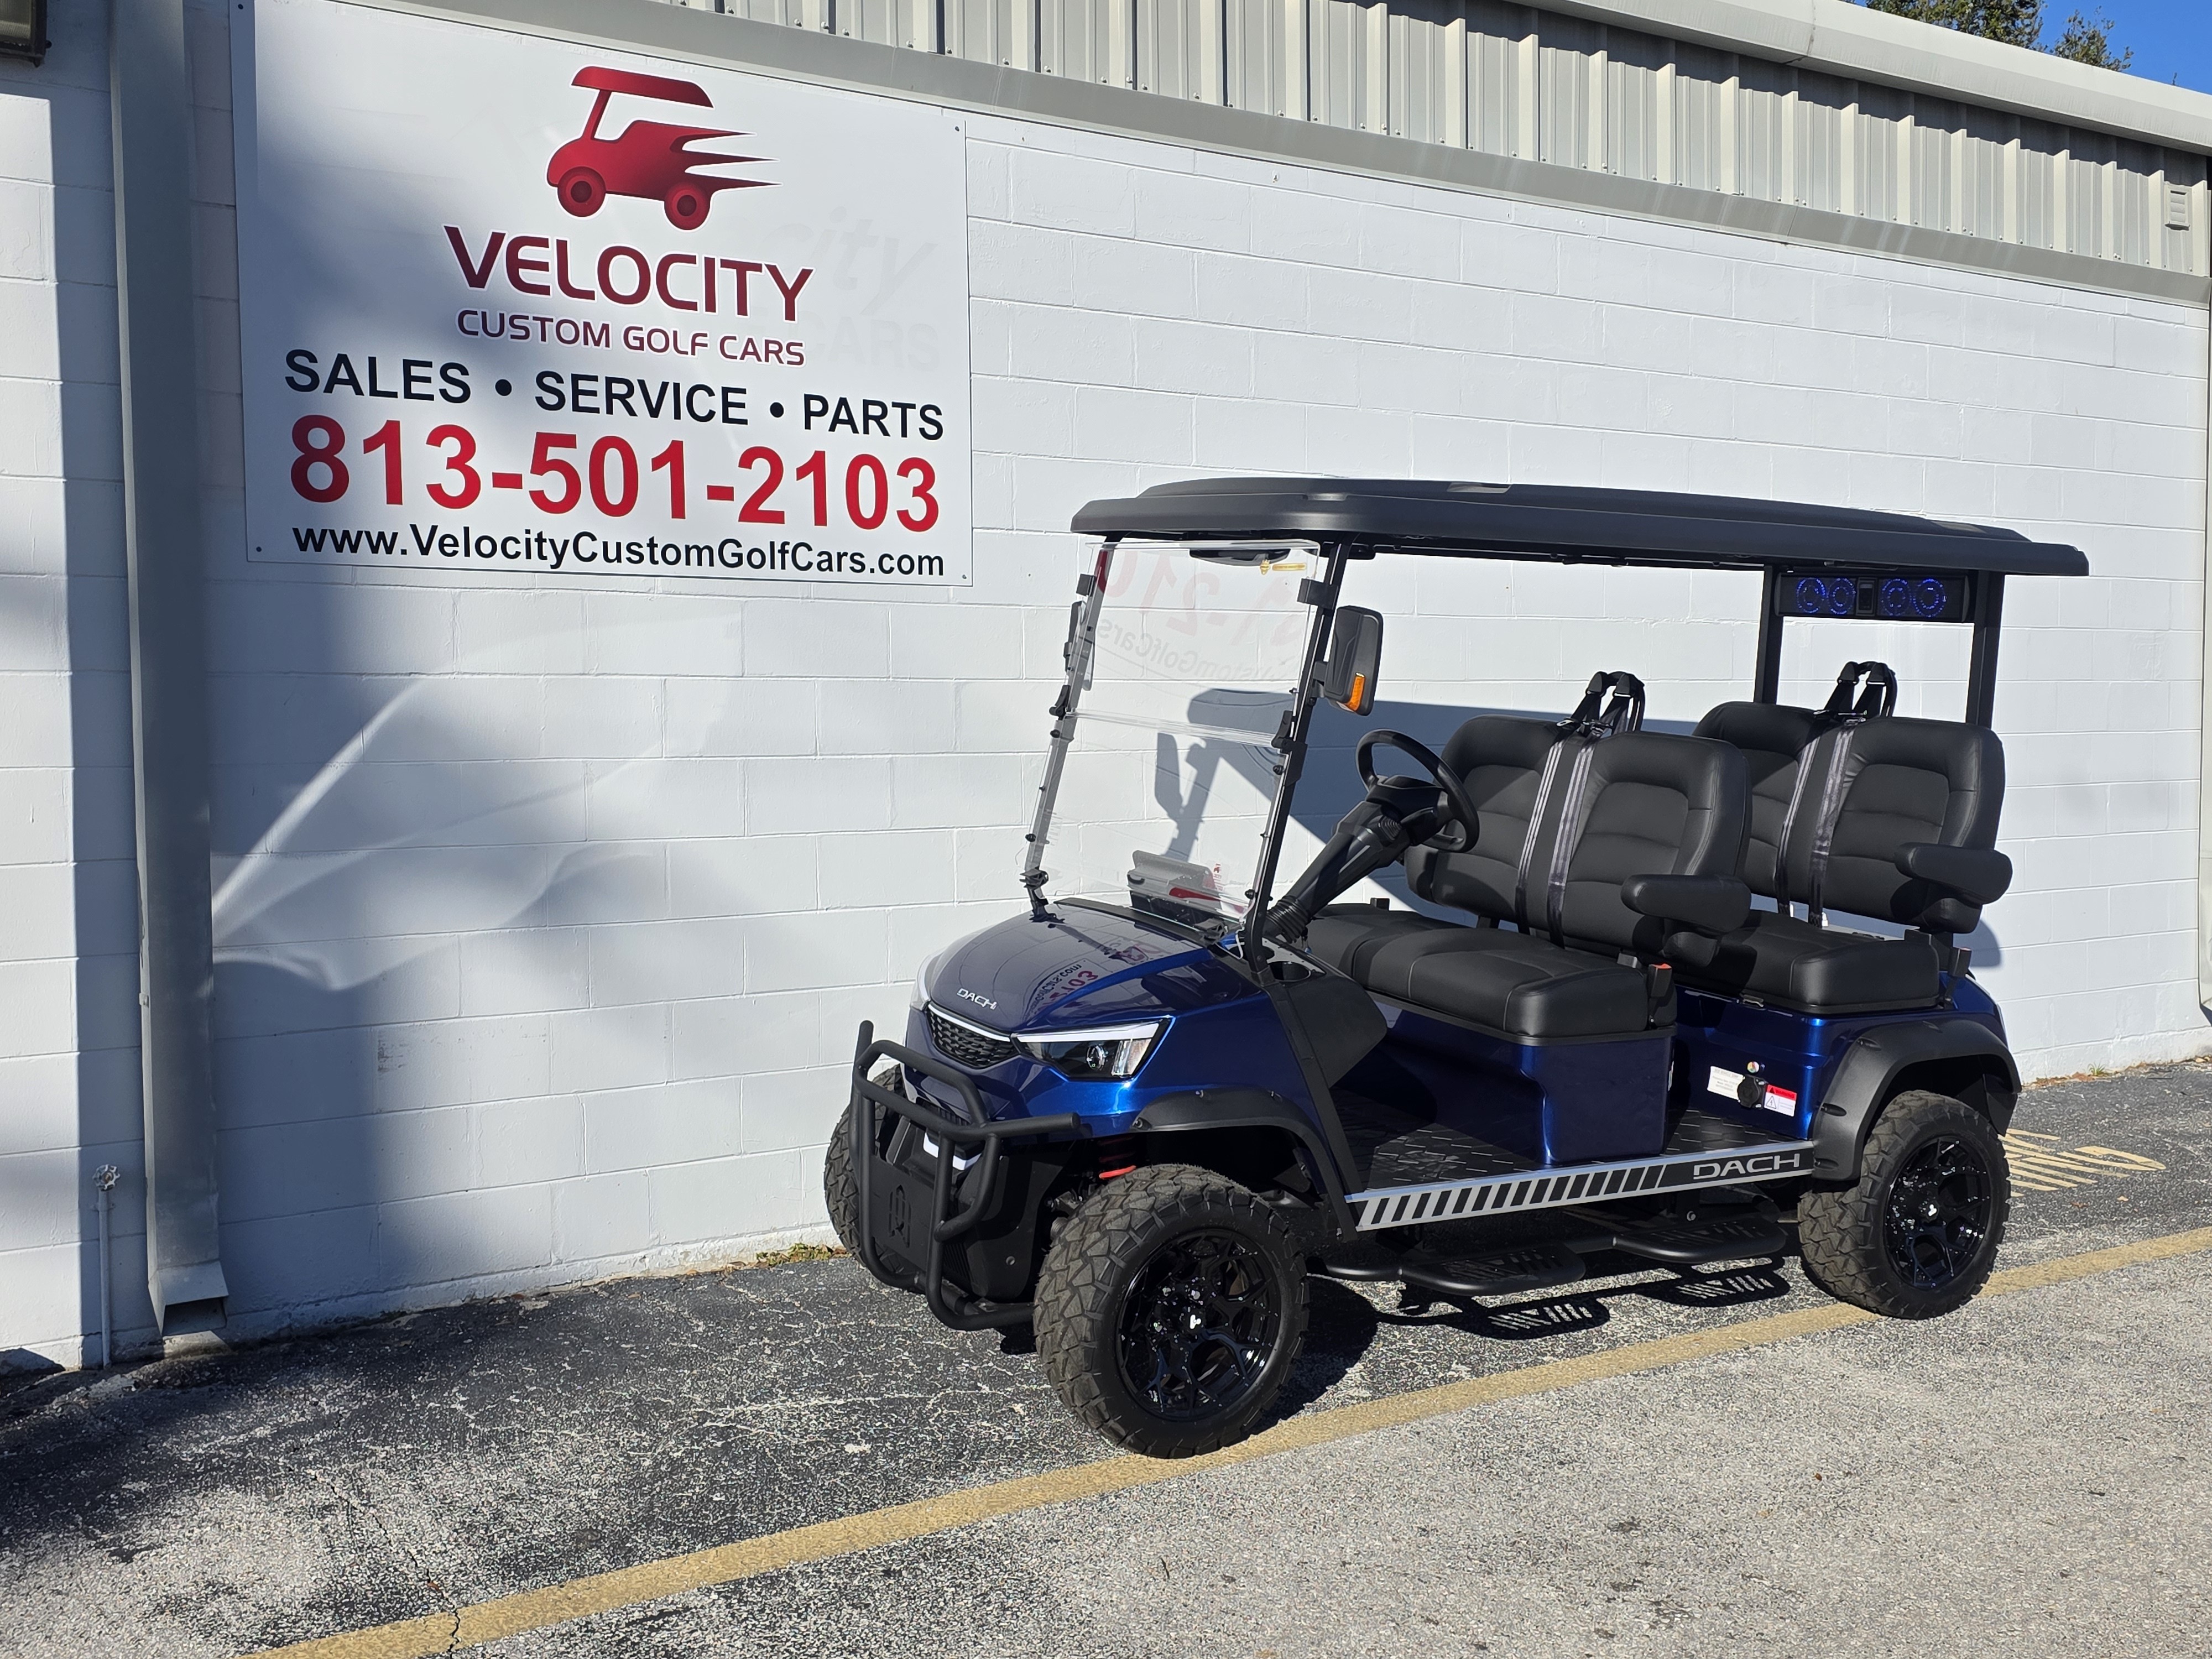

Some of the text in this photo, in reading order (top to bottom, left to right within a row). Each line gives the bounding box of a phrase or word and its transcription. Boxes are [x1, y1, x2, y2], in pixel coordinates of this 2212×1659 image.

[444, 226, 813, 322] VELOCITY
[457, 309, 805, 366] CUSTOM GOLF CARS
[284, 348, 944, 441] SALES SERVICE PARTS
[290, 414, 940, 534] 813-501-2103
[292, 522, 944, 577] www.VelocityCustomGolfCars.com
[956, 988, 998, 1010] DACH
[1693, 1154, 1800, 1180] DACH
